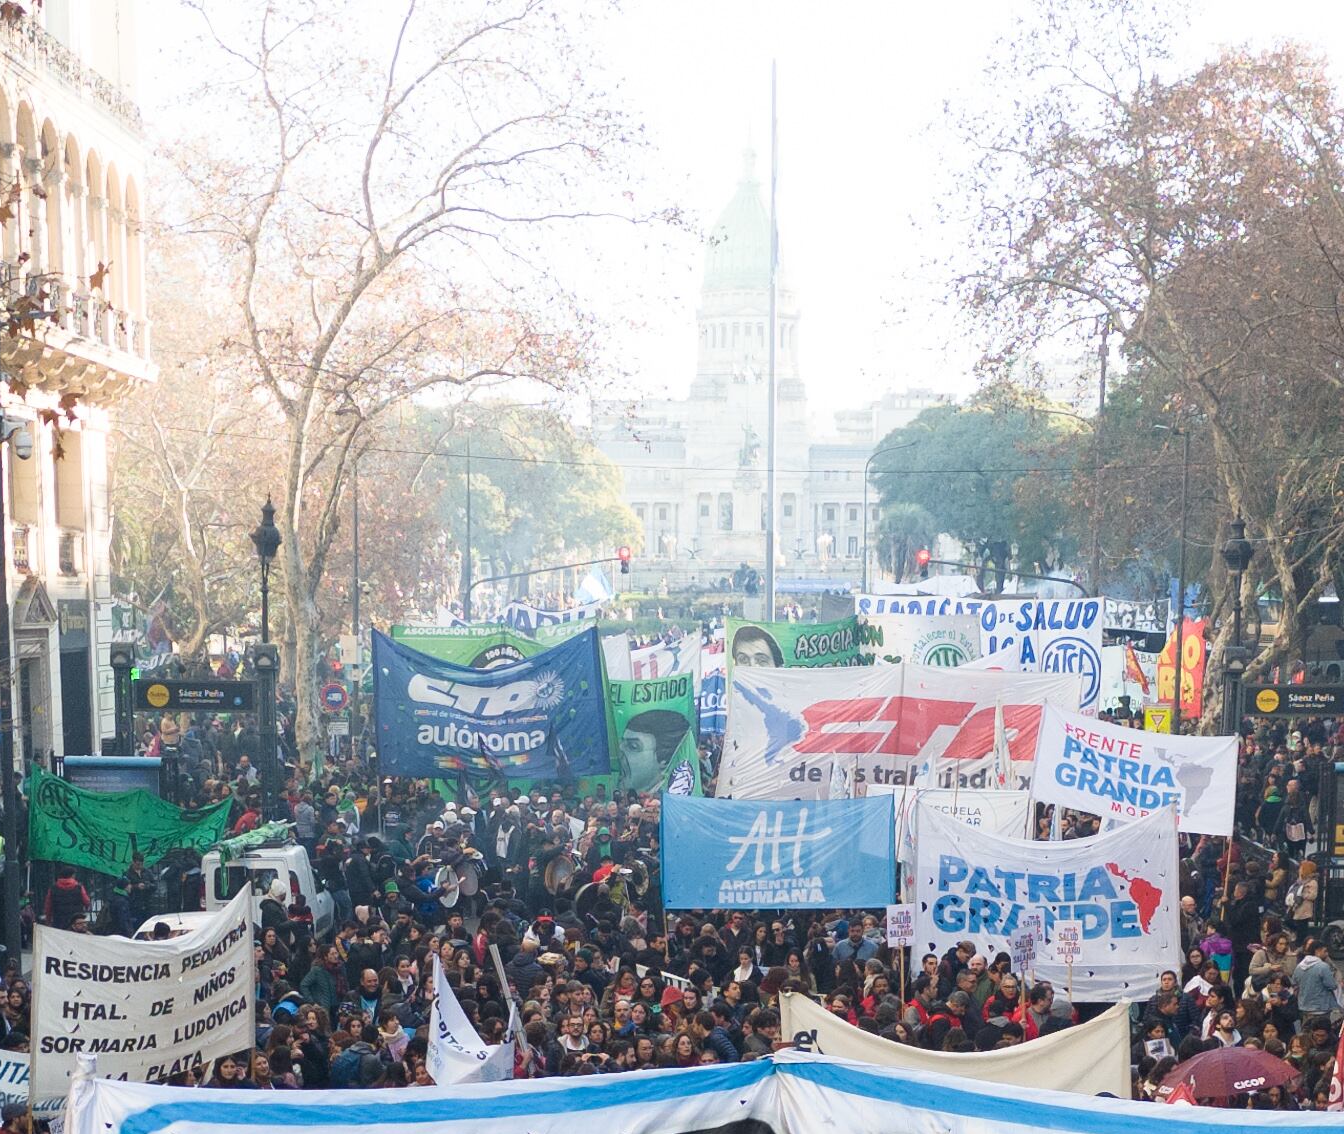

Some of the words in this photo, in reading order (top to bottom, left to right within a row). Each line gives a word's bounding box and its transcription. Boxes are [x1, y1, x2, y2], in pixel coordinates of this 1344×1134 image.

[403, 626, 469, 636] ASOCIACIÓN
[999, 612, 1015, 624] DE
[1016, 601, 1099, 632] SALUD
[631, 677, 688, 703] ESTADO
[1288, 693, 1313, 702] Sáenz
[1314, 693, 1335, 702] Peña
[417, 722, 545, 752] autónoma
[1064, 721, 1143, 760] FRENTE
[789, 762, 822, 783] de
[1063, 735, 1175, 788] PATRIA
[1055, 762, 1182, 811] GRANDE
[56, 819, 117, 864] San
[719, 876, 824, 891] ARGENTINA
[939, 853, 1118, 903] PATRIA
[718, 889, 827, 904] HUMANA
[45, 956, 171, 984] RESIDENCIA
[62, 1001, 128, 1021] HTAL.
[149, 997, 175, 1017] DE
[193, 966, 236, 1006] NIÑOS
[40, 1036, 86, 1054] SOR
[89, 1033, 157, 1053] MARIA
[173, 995, 247, 1045] LUDOVICA
[145, 1050, 203, 1082] PLATA
[1233, 1076, 1266, 1090] CICOP
